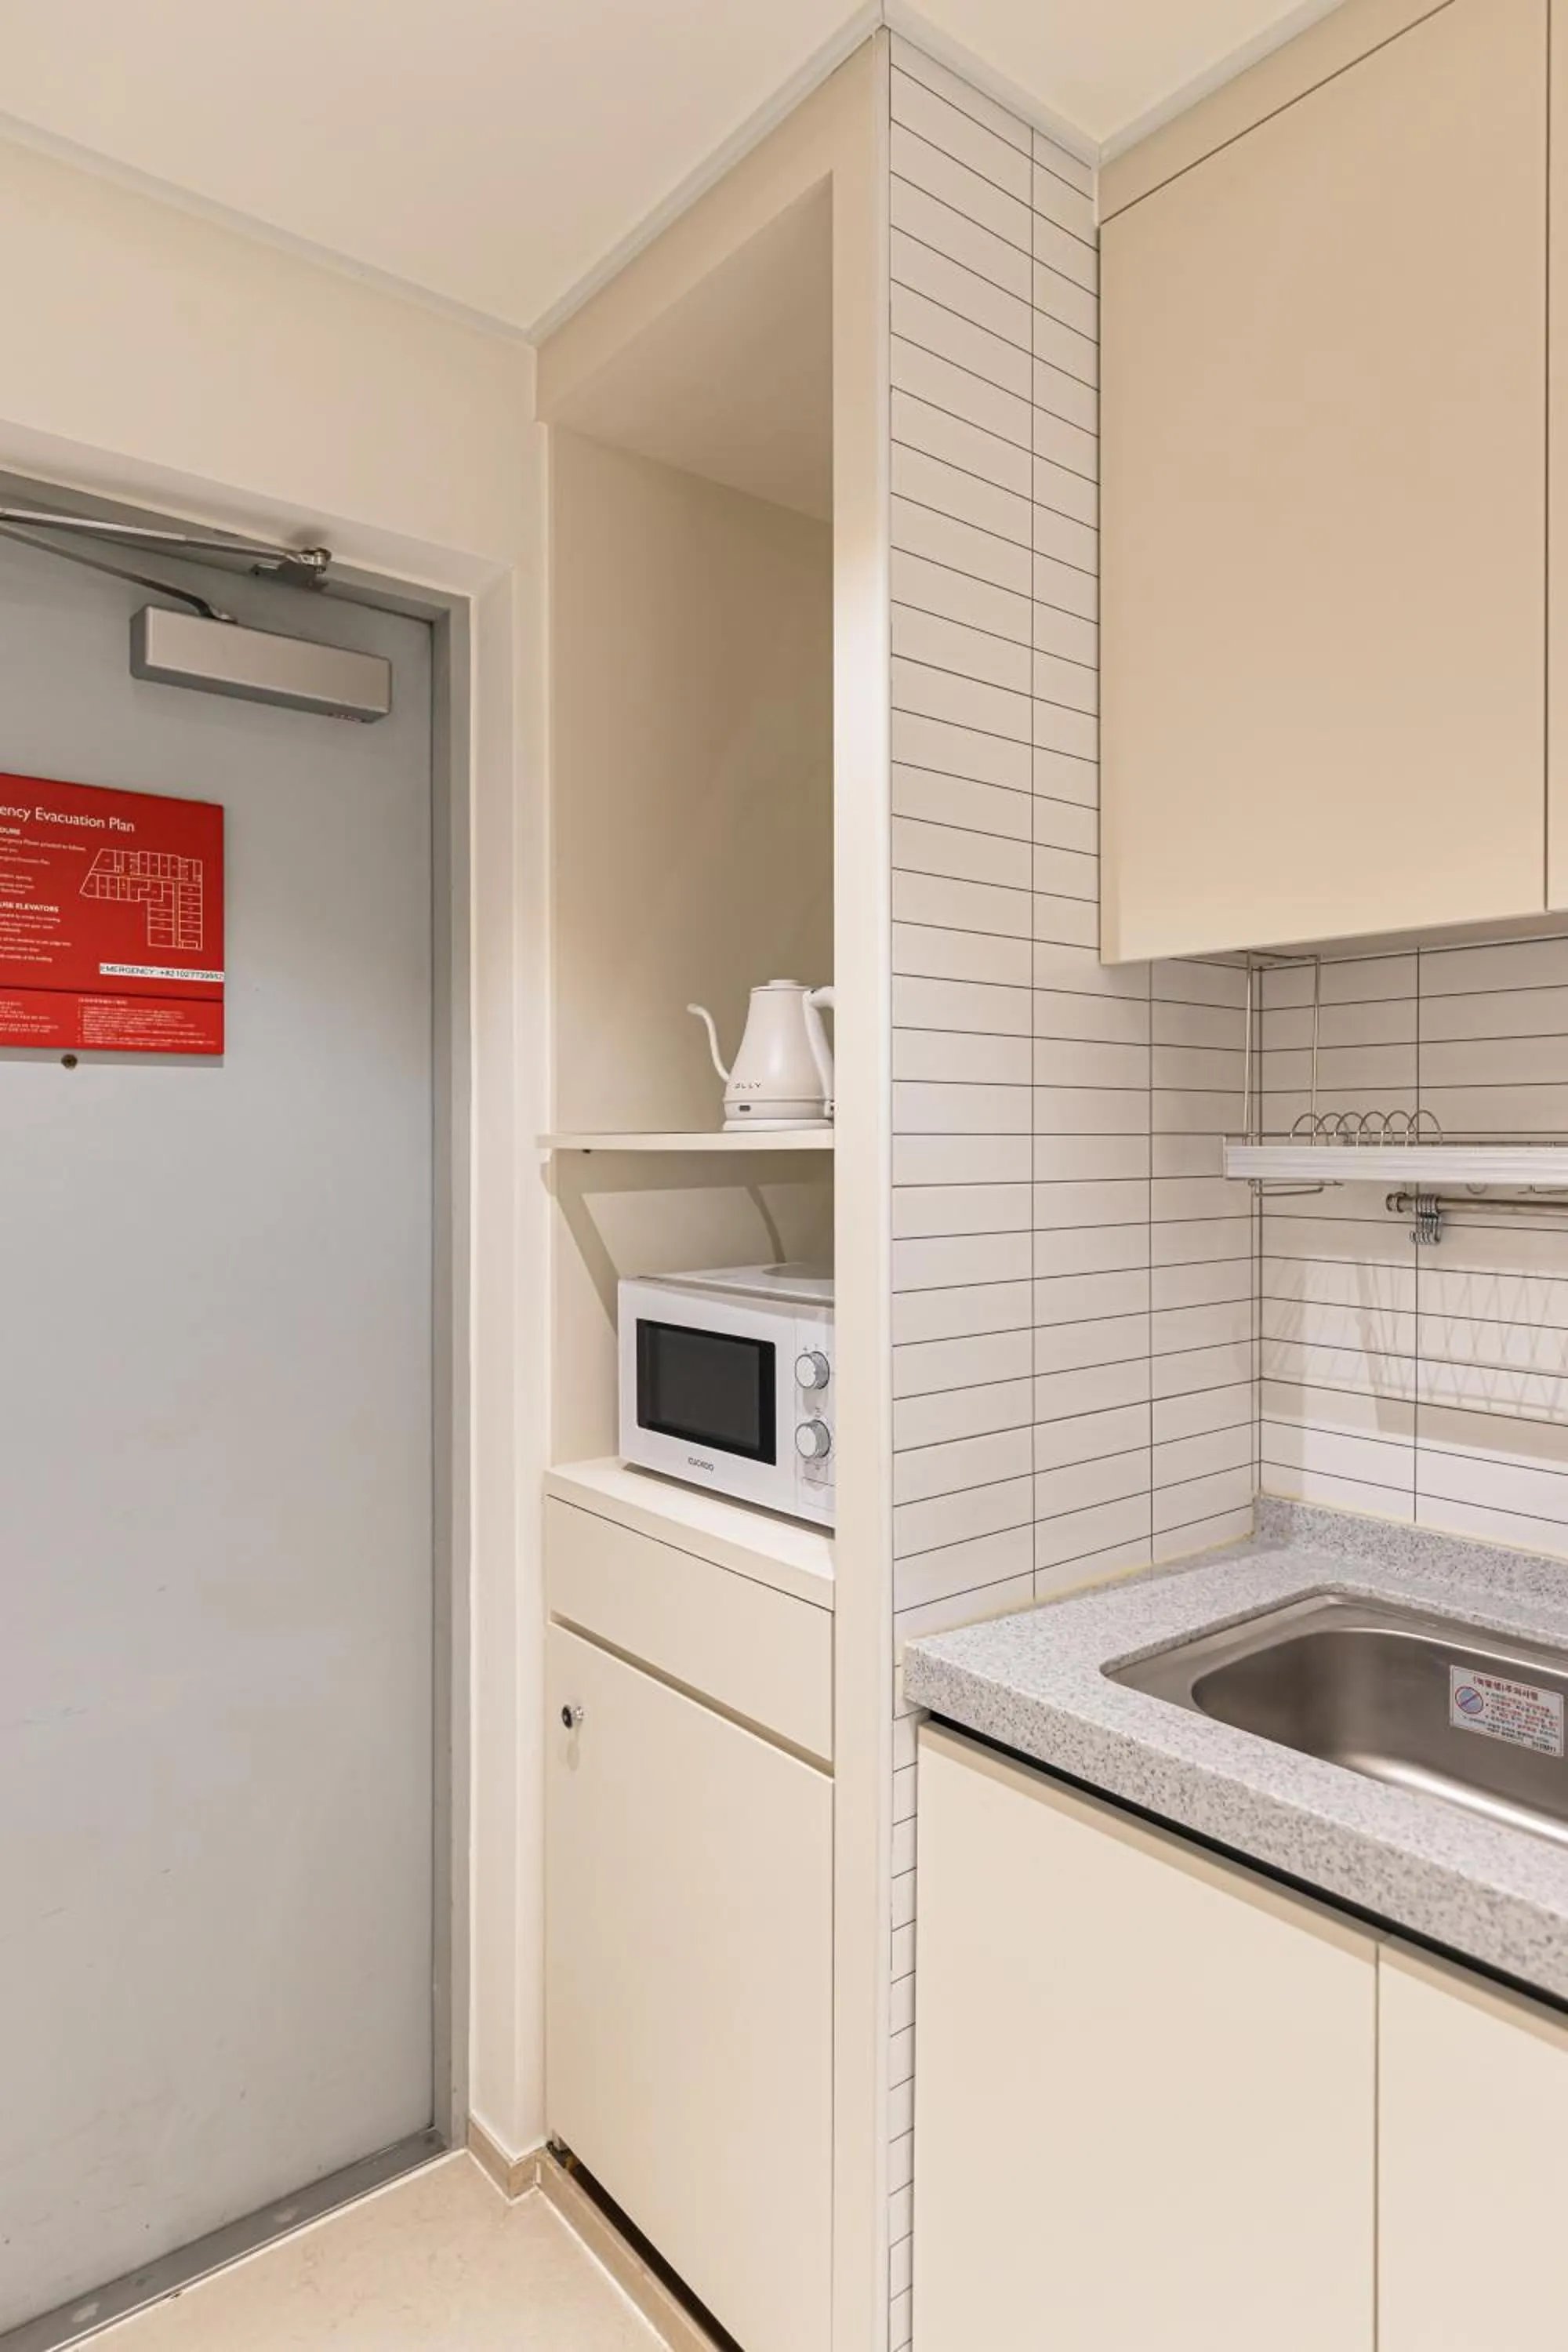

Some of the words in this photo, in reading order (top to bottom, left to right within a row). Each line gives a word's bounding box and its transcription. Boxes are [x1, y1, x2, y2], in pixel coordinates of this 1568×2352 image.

[35, 807, 105, 828] Evacuation
[109, 817, 136, 833] Plan
[16, 902, 60, 913] ELEVATORS
